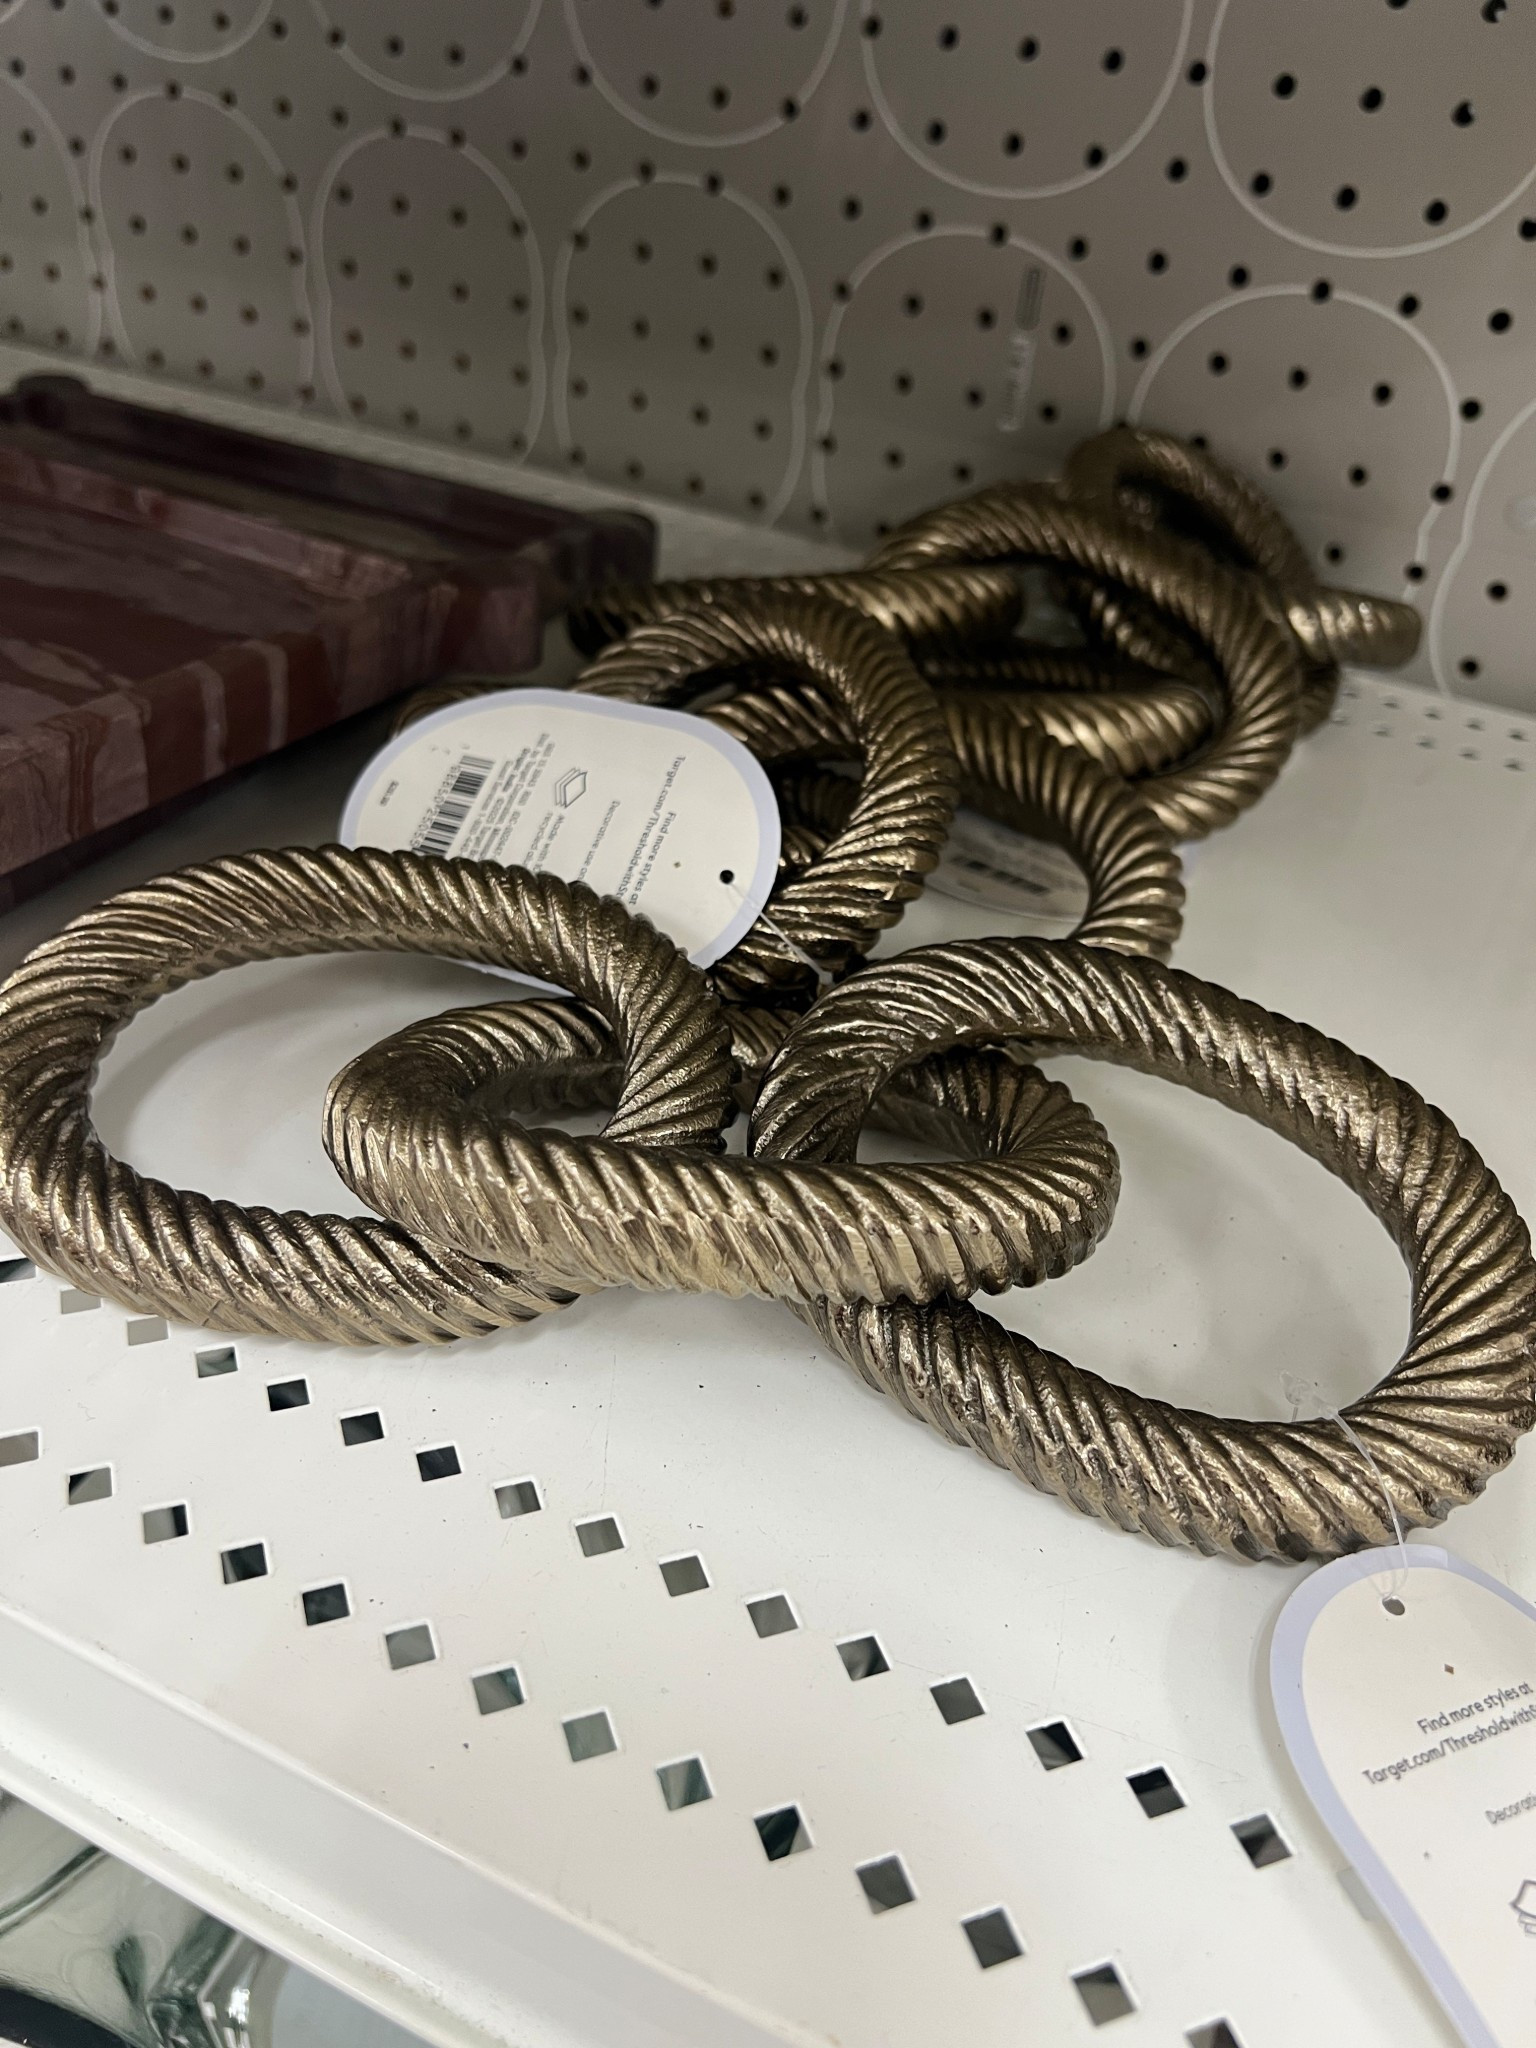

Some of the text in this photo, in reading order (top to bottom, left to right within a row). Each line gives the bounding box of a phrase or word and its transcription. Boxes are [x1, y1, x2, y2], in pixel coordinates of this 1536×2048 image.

[531, 811, 554, 851] recycled
[548, 813, 565, 842] Made
[591, 800, 621, 850] Decorative
[537, 842, 551, 863] with
[583, 850, 596, 867] use
[628, 811, 677, 906] Find more styles at
[1416, 1681, 1534, 1735] Find more styles at
